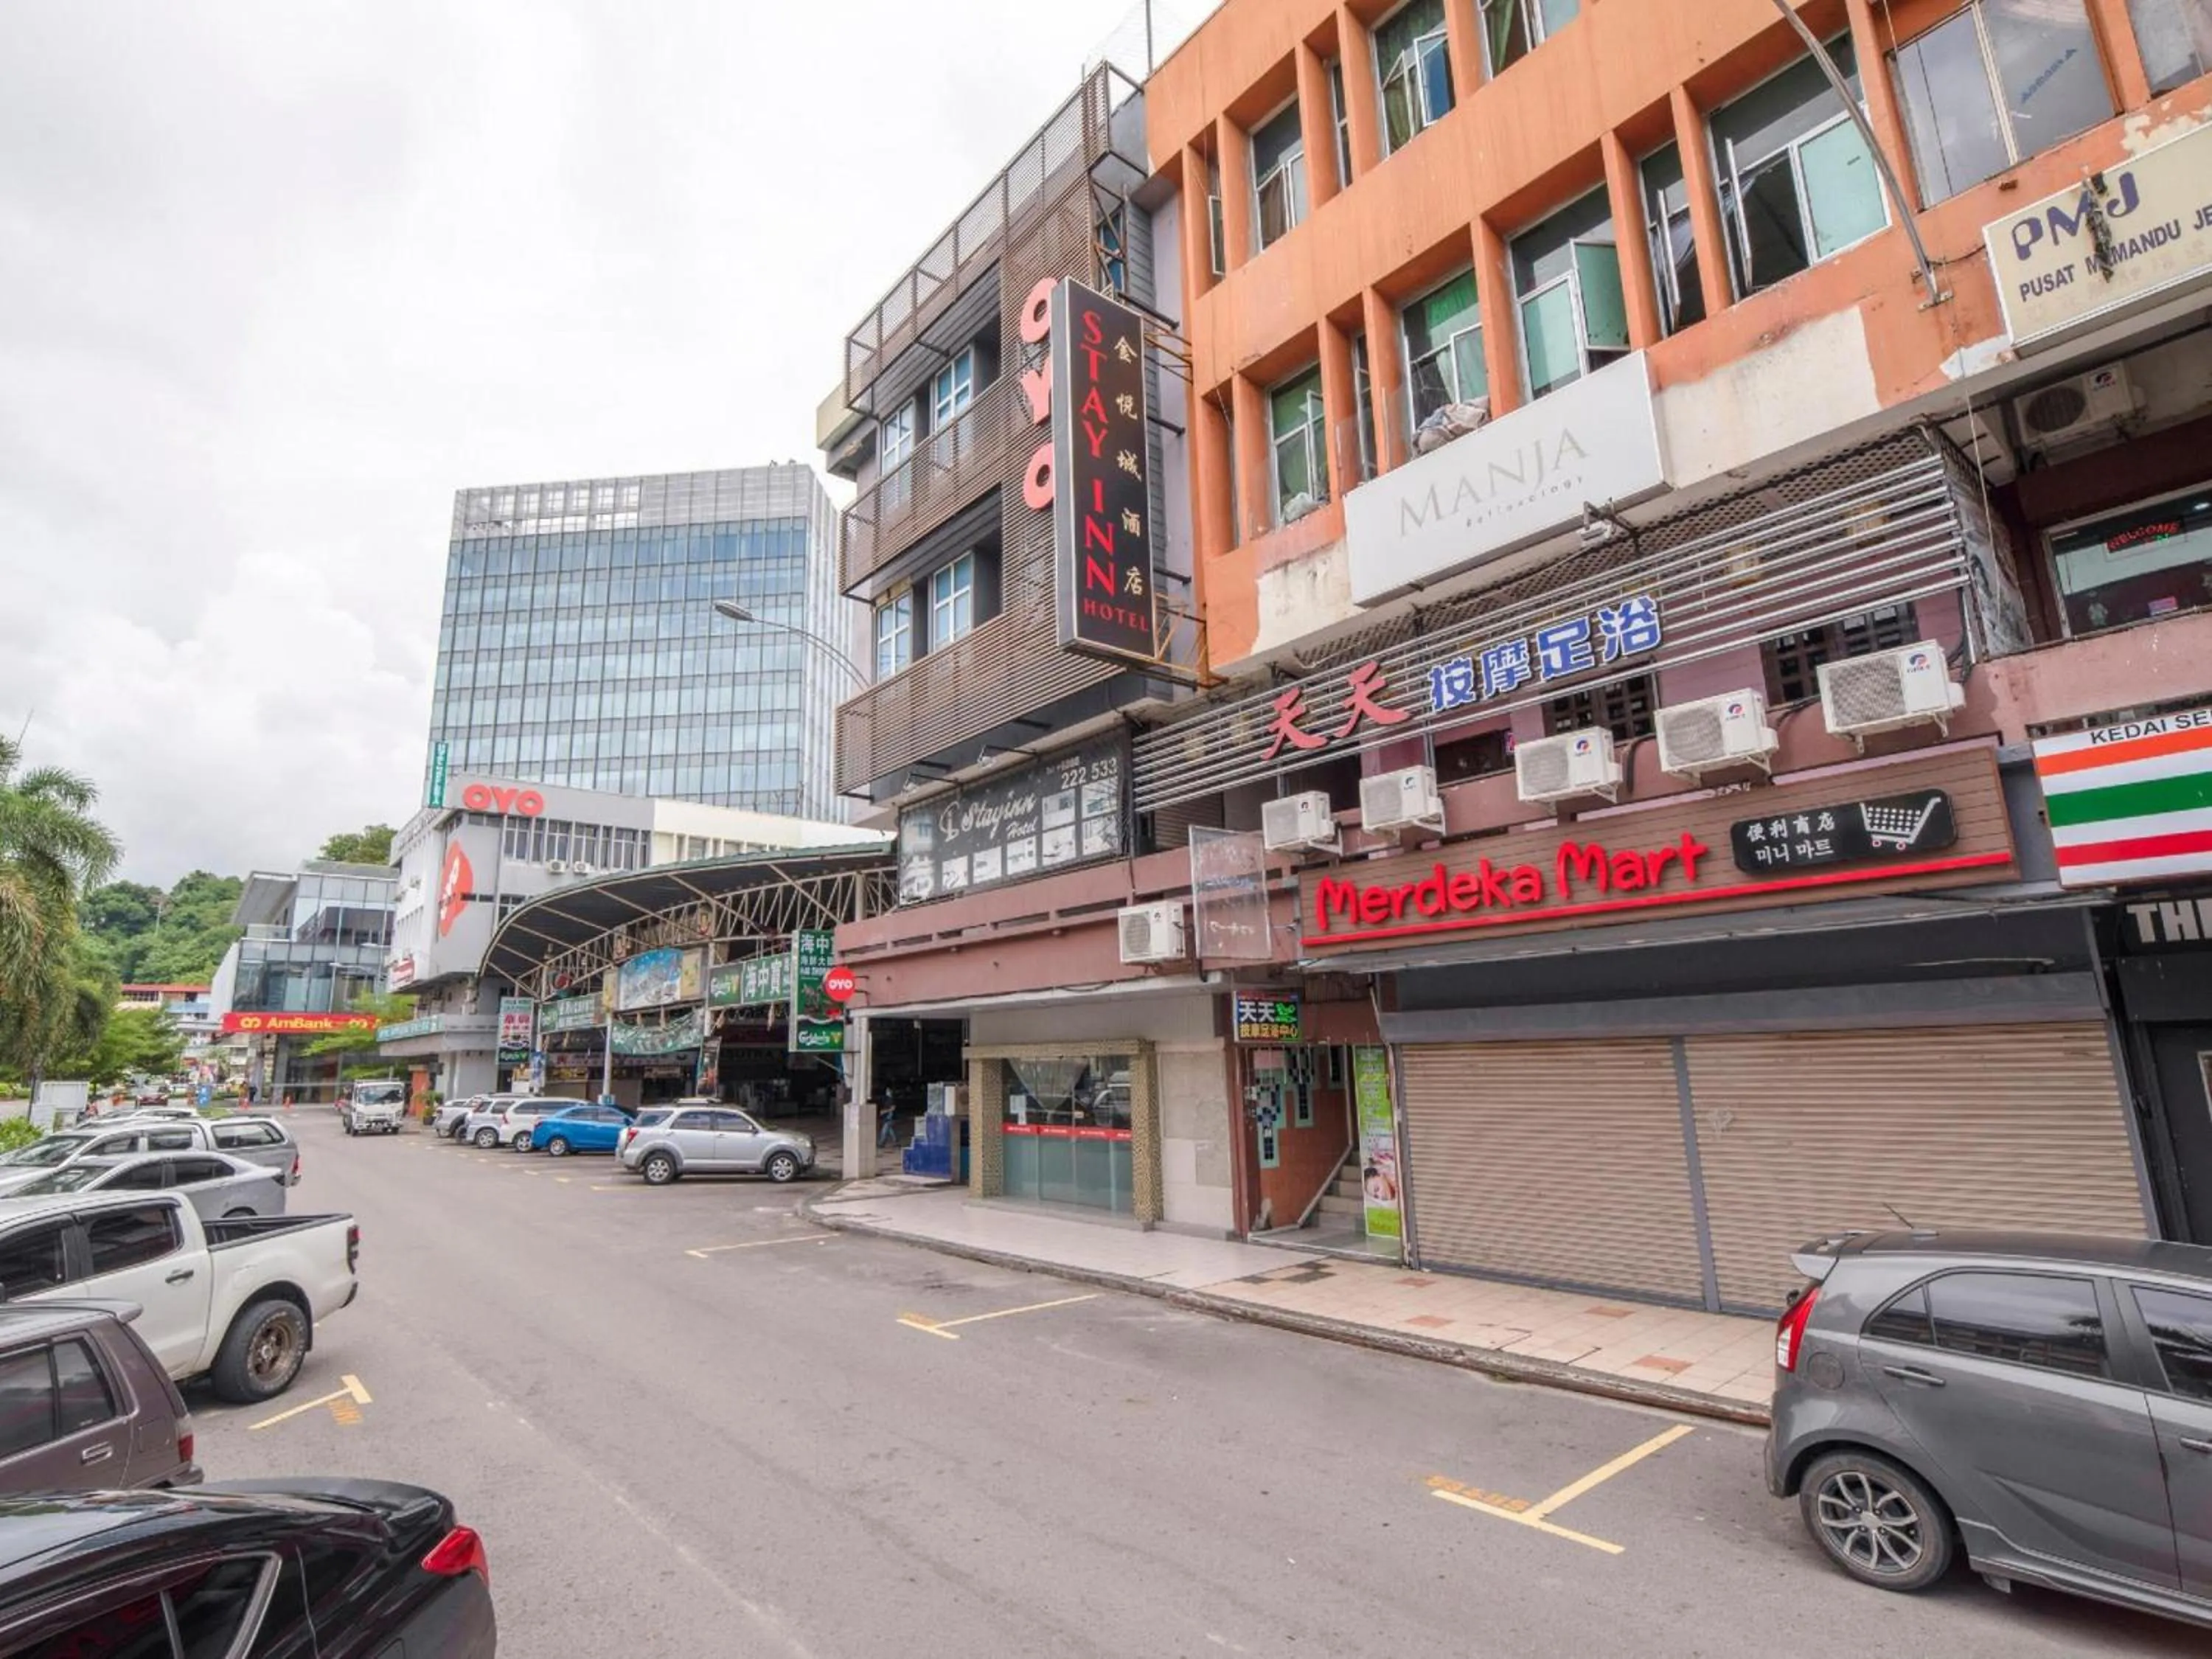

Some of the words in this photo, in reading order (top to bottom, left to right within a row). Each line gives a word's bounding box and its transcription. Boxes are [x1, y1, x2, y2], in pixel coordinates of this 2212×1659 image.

[2011, 172, 2140, 260] PMJ
[2019, 264, 2075, 302] PUSAT
[2084, 219, 2181, 276] MMANDU
[1079, 310, 1109, 459] STAY
[1399, 428, 1591, 537] MANJA
[1085, 479, 1116, 598] INN
[1083, 598, 1149, 632] HOTEL
[1261, 660, 1411, 761] 天天
[2090, 718, 2167, 744] KEDAI
[2175, 709, 2212, 728] SE
[1061, 766, 1087, 790] 222
[1091, 757, 1117, 780] 533
[463, 784, 544, 816] OYO
[1315, 857, 1543, 931] Merdeka
[1555, 831, 1708, 899] Mart
[801, 933, 835, 955] 海中
[828, 978, 853, 990] OYO
[267, 1017, 333, 1029] AmBank
[1239, 1001, 1275, 1023] 天天
